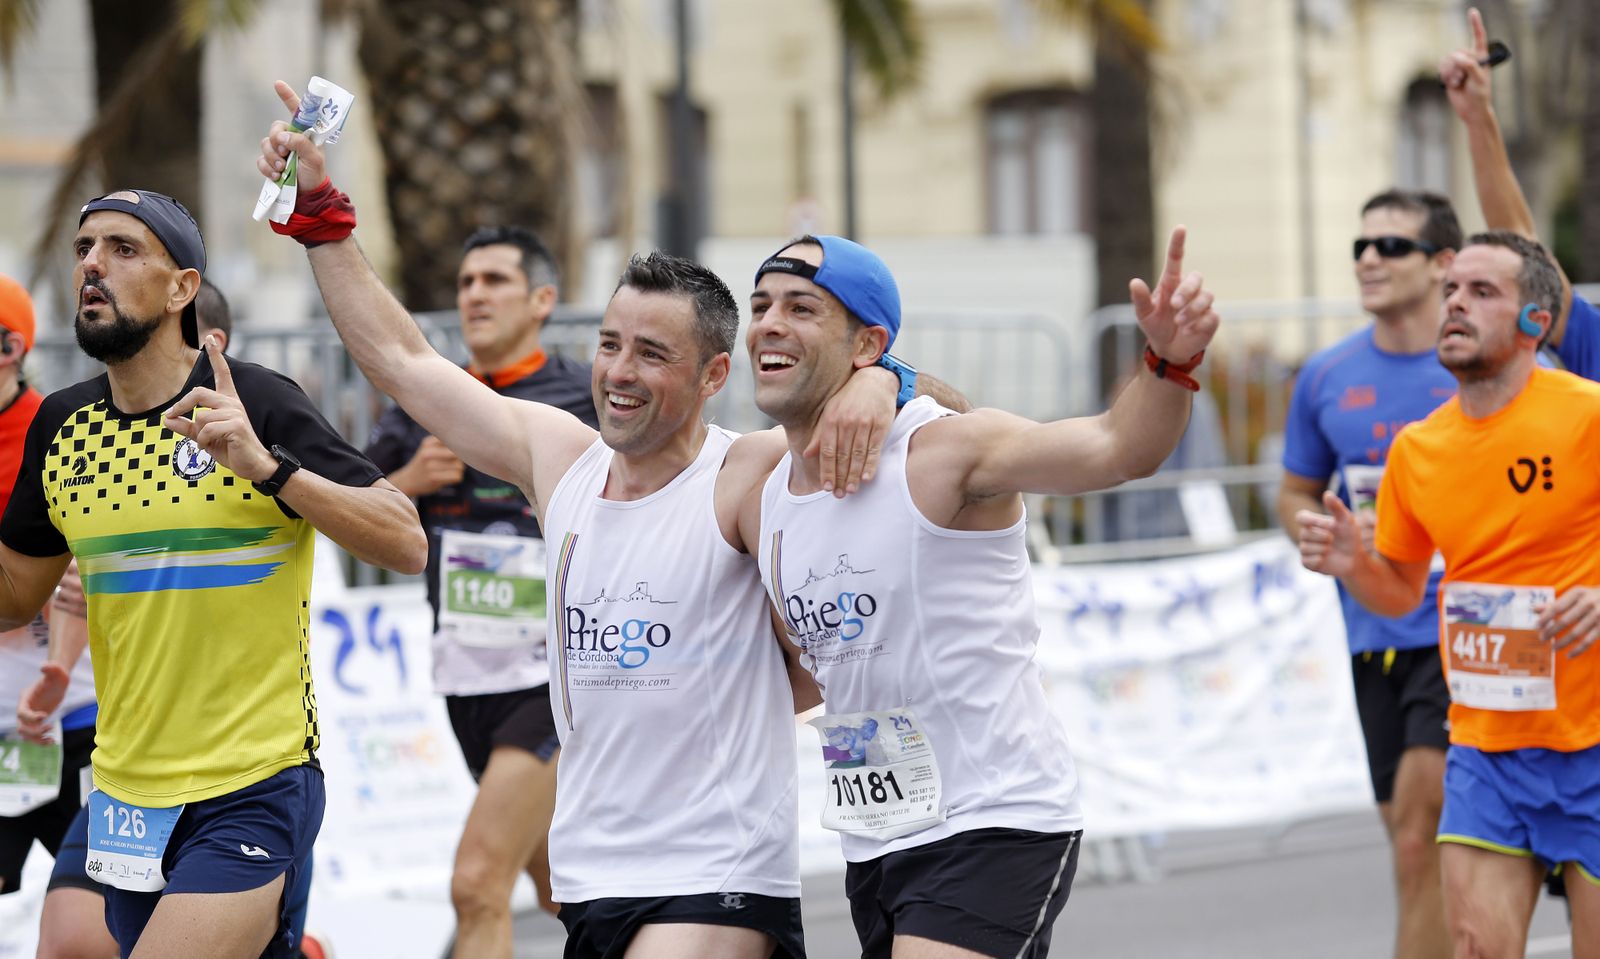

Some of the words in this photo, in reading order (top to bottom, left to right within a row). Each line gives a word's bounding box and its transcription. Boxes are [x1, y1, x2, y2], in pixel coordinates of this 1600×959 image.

[766, 260, 793, 269] Columbia
[63, 474, 96, 488] VIATOR
[452, 576, 514, 609] 1140
[786, 591, 877, 641] Priego
[566, 605, 671, 669] Priego
[1452, 630, 1506, 663] 4417
[567, 651, 577, 661] de
[579, 650, 620, 662] Córdoba
[573, 675, 671, 690] turismodepriego.com
[832, 770, 904, 807] 10181
[103, 804, 146, 839] 126
[88, 859, 103, 875] edp
